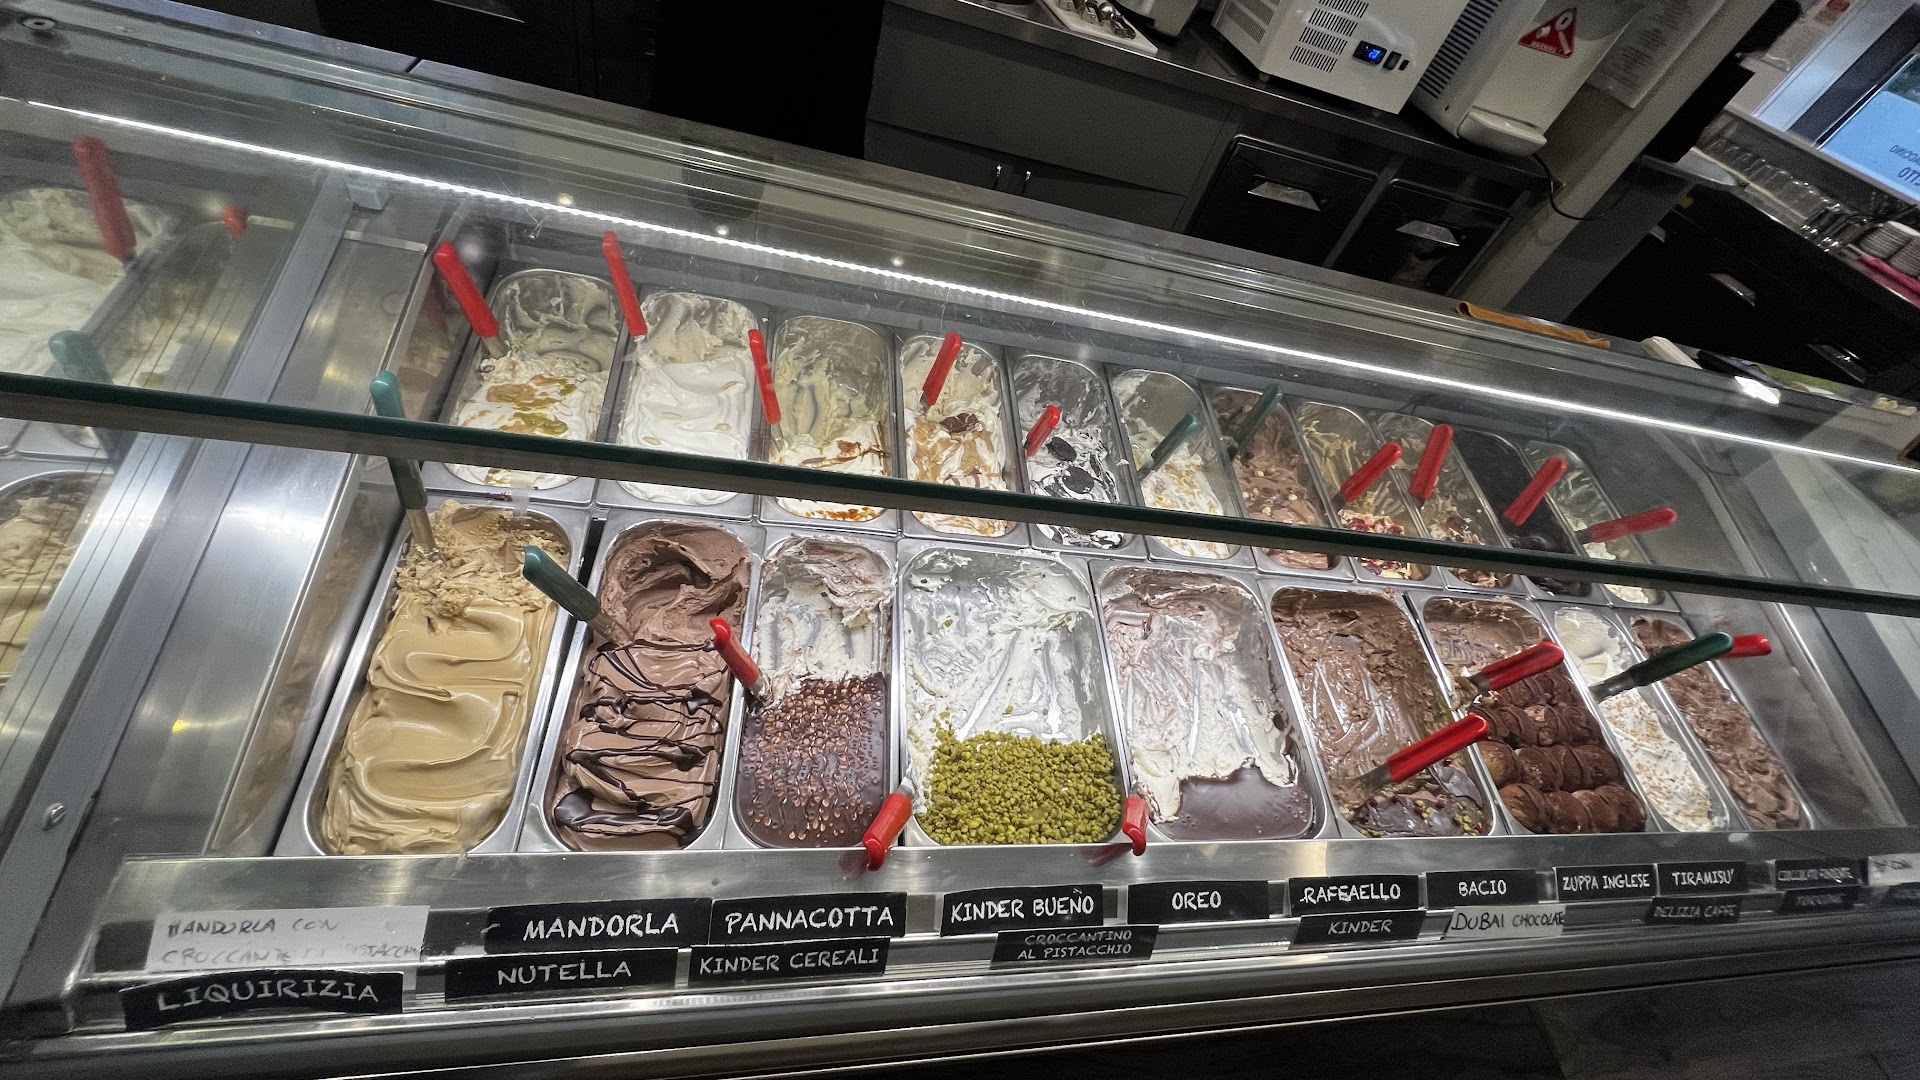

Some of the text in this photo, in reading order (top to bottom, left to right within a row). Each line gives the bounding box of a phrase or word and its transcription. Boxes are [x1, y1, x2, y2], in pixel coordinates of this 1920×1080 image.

[1458, 879, 1507, 896] BACIO
[1562, 873, 1650, 892] ZUPPA INGLESE
[951, 899, 1025, 923] KINDER
[1171, 890, 1222, 911] OREO
[523, 912, 680, 941] MANDORLA
[724, 905, 894, 934] PANNACOTTA
[1327, 919, 1393, 935] KINDER
[1024, 929, 1133, 946] CROCCANTINO
[700, 948, 880, 975] KINDER CEREALI
[1017, 943, 1132, 960] AL PISTACCHIO
[497, 959, 632, 986] NUTELLA
[158, 979, 379, 1011] LIQUIRIZIA
